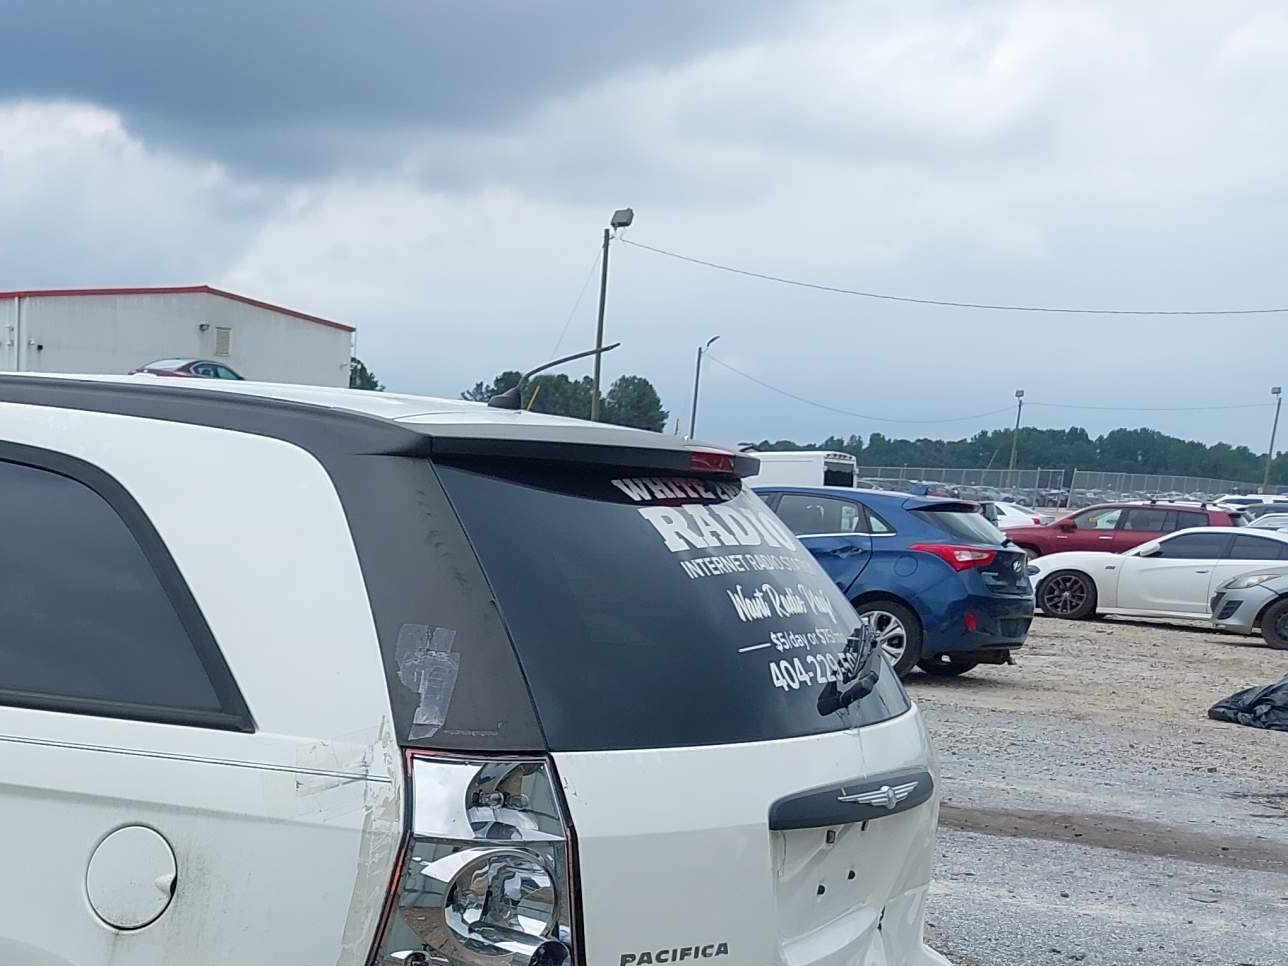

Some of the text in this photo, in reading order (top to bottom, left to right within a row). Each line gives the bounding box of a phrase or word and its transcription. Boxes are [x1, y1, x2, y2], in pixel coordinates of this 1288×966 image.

[611, 478, 716, 501] WHITE
[638, 503, 797, 553] RADIO
[680, 554, 750, 580] INTERNET
[726, 585, 772, 622] Want
[770, 631, 811, 653] $5/day
